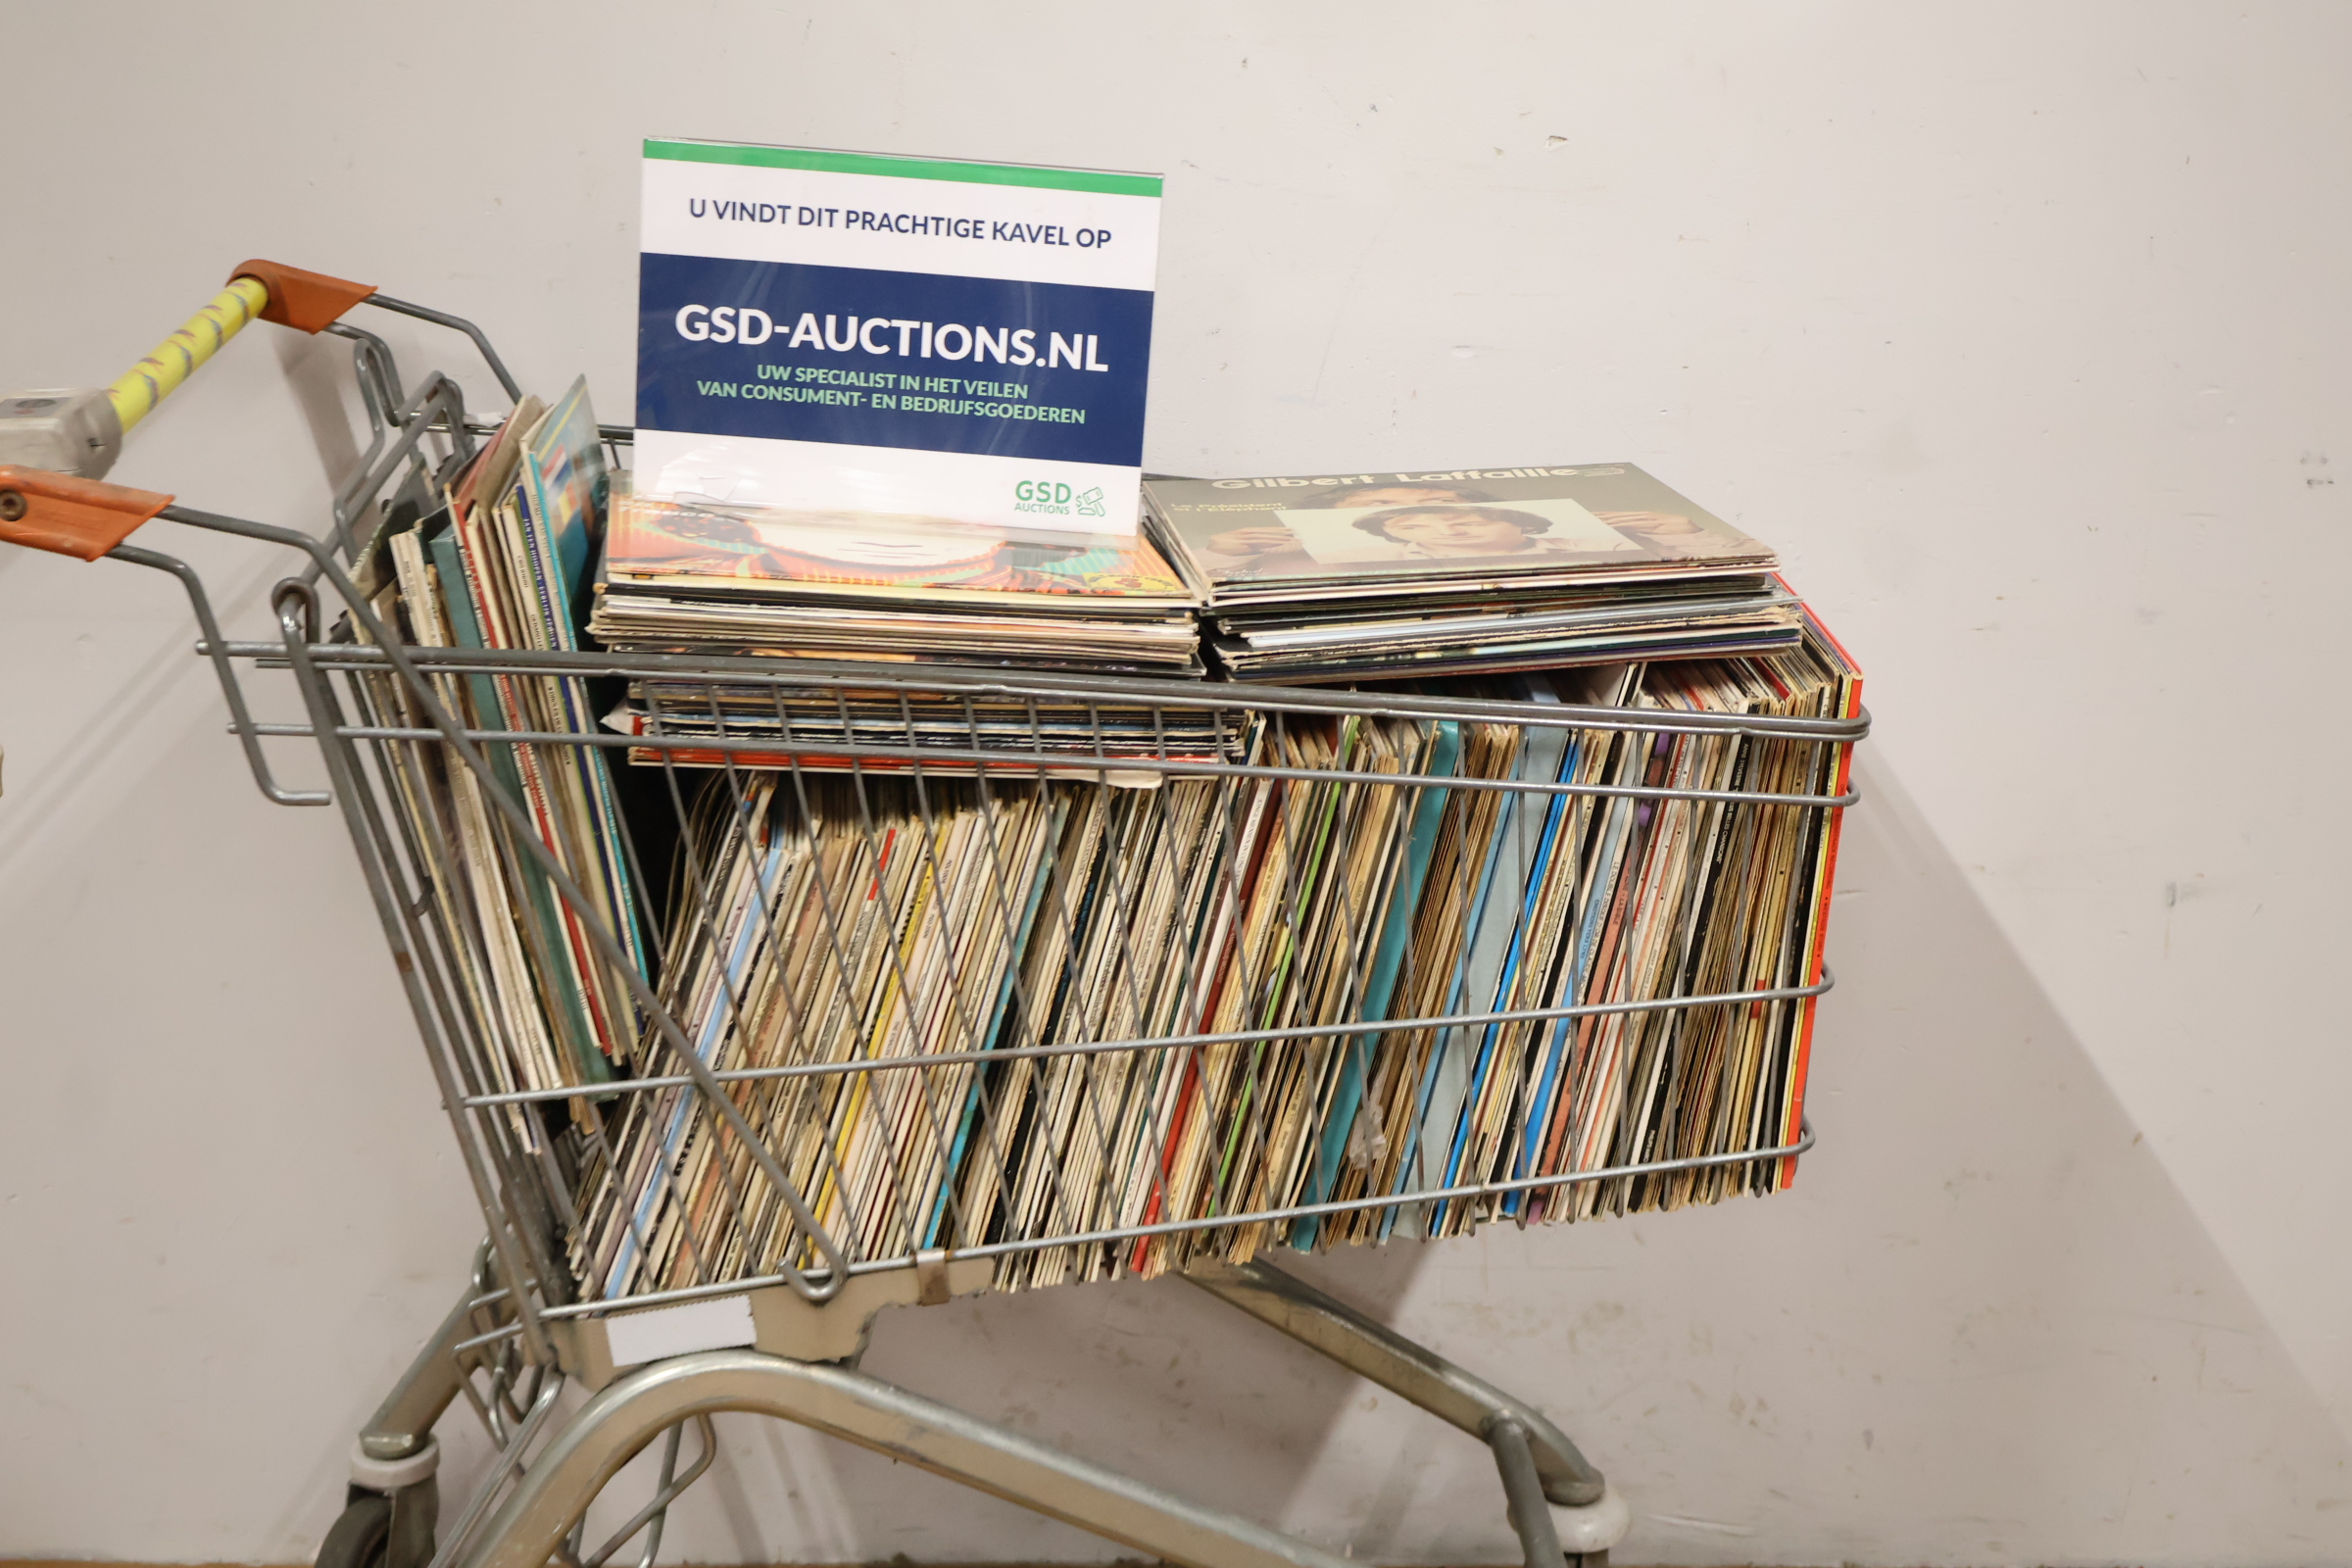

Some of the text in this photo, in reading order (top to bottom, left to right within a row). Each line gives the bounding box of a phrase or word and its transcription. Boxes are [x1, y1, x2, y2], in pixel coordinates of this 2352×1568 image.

[690, 198, 1112, 249] U VINDT DIT PRACHTIGE KAVEL OP
[675, 304, 1109, 372] GSD-AUCTIONS.NL
[757, 364, 1029, 399] UW SPECIALIST IN HET VEILEN
[697, 380, 1086, 424] VAN CONSUMENT- EN BEDRIJFSGOEDEREN
[1211, 473, 1375, 489] Gilbert
[1396, 467, 1578, 483] Laffaille
[1015, 480, 1071, 504] GSD
[1014, 503, 1070, 514] AUCTIONS
[1723, 810, 1733, 830] BELLES
[1611, 860, 1620, 870] LE
[1604, 869, 1617, 897] DOUBLE
[1597, 897, 1609, 921] DISQUE
